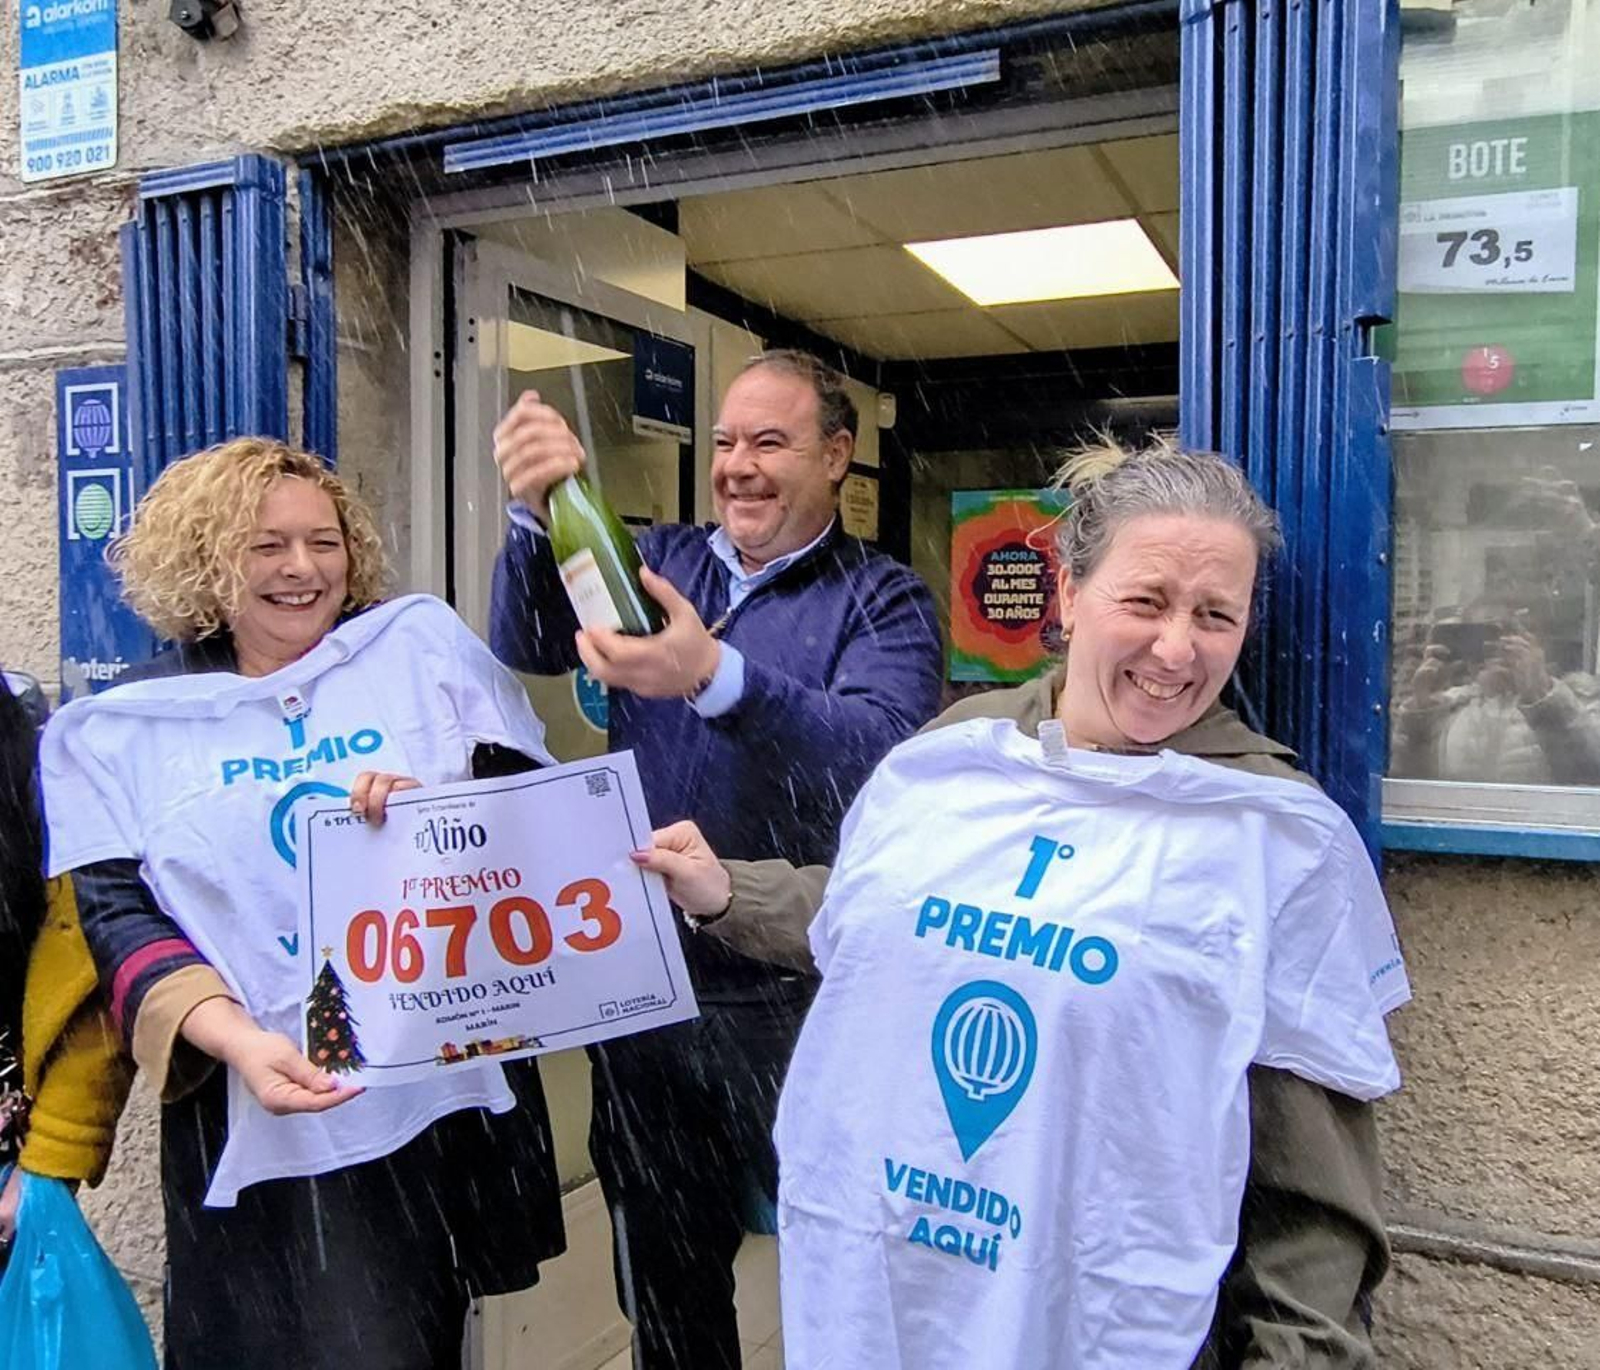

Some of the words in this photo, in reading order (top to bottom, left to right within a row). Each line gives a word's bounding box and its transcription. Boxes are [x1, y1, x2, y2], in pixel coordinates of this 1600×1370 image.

[24, 66, 81, 91] ALARMA
[27, 156, 52, 173] 900
[56, 150, 82, 168] 920
[86, 145, 110, 163] 021
[1448, 137, 1529, 180] BOTE
[1436, 229, 1533, 268] 73,5
[987, 563, 1045, 575] 30.000€
[991, 551, 1038, 561] AHORA
[984, 593, 1044, 605] DURANTE
[991, 579, 1009, 590] AL
[1010, 579, 1036, 590] MES
[987, 608, 1004, 619] 30
[1005, 605, 1040, 620] AÑOS
[221, 729, 383, 785] PREMIO
[420, 867, 522, 902] PREMIO
[346, 878, 622, 983] 06703
[915, 896, 1119, 984] PREMIO
[389, 983, 487, 1011] VENDIDO
[492, 966, 556, 996] AQUÍ
[622, 997, 668, 1014] NACIONAL
[884, 1158, 1021, 1239] VENDIDO
[908, 1217, 1001, 1272] AQUÍ
